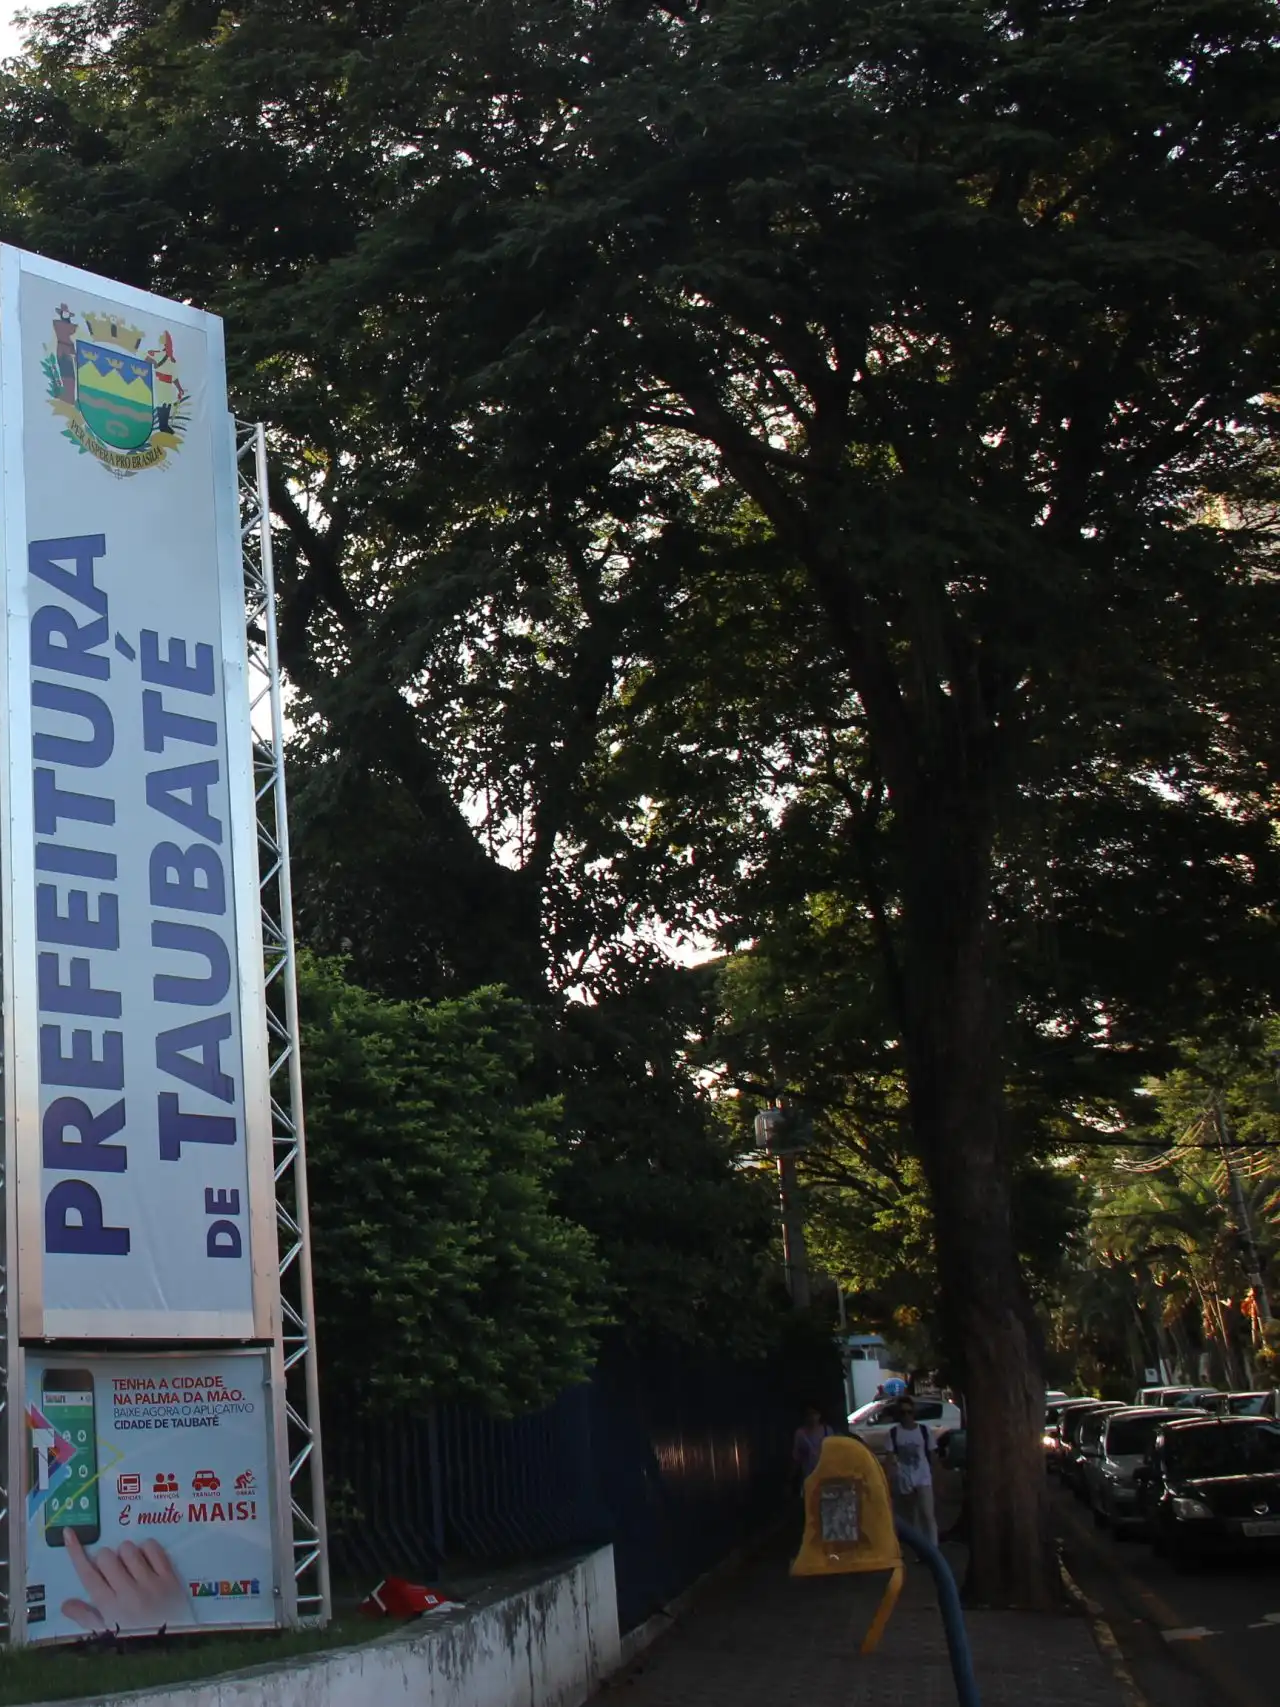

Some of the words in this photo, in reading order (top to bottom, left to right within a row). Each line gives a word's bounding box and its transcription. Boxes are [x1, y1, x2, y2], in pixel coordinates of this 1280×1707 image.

[71, 419, 86, 442] PER
[84, 437, 115, 467] ASPERA
[115, 453, 131, 469] PRO
[28, 533, 131, 1256] PREFEITURA
[114, 628, 237, 1161] TAUBATÉ
[204, 1186, 242, 1259] DE
[112, 1377, 156, 1391] TENHA
[159, 1378, 169, 1390] A
[171, 1376, 224, 1389] CIDADE
[113, 1391, 132, 1406] NA
[135, 1392, 180, 1405] PALMA
[183, 1391, 203, 1403] DA
[207, 1387, 246, 1402] MÃO.
[114, 1407, 140, 1418] BAIXE
[142, 1405, 180, 1417] AGORA
[181, 1405, 192, 1416] O
[193, 1402, 255, 1416] APLICATIVO
[114, 1419, 153, 1430] CIDADE
[154, 1418, 169, 1429] DE
[171, 1414, 220, 1428] TAUBATÉ
[137, 1502, 183, 1525] muito
[188, 1501, 257, 1522] MAIS!
